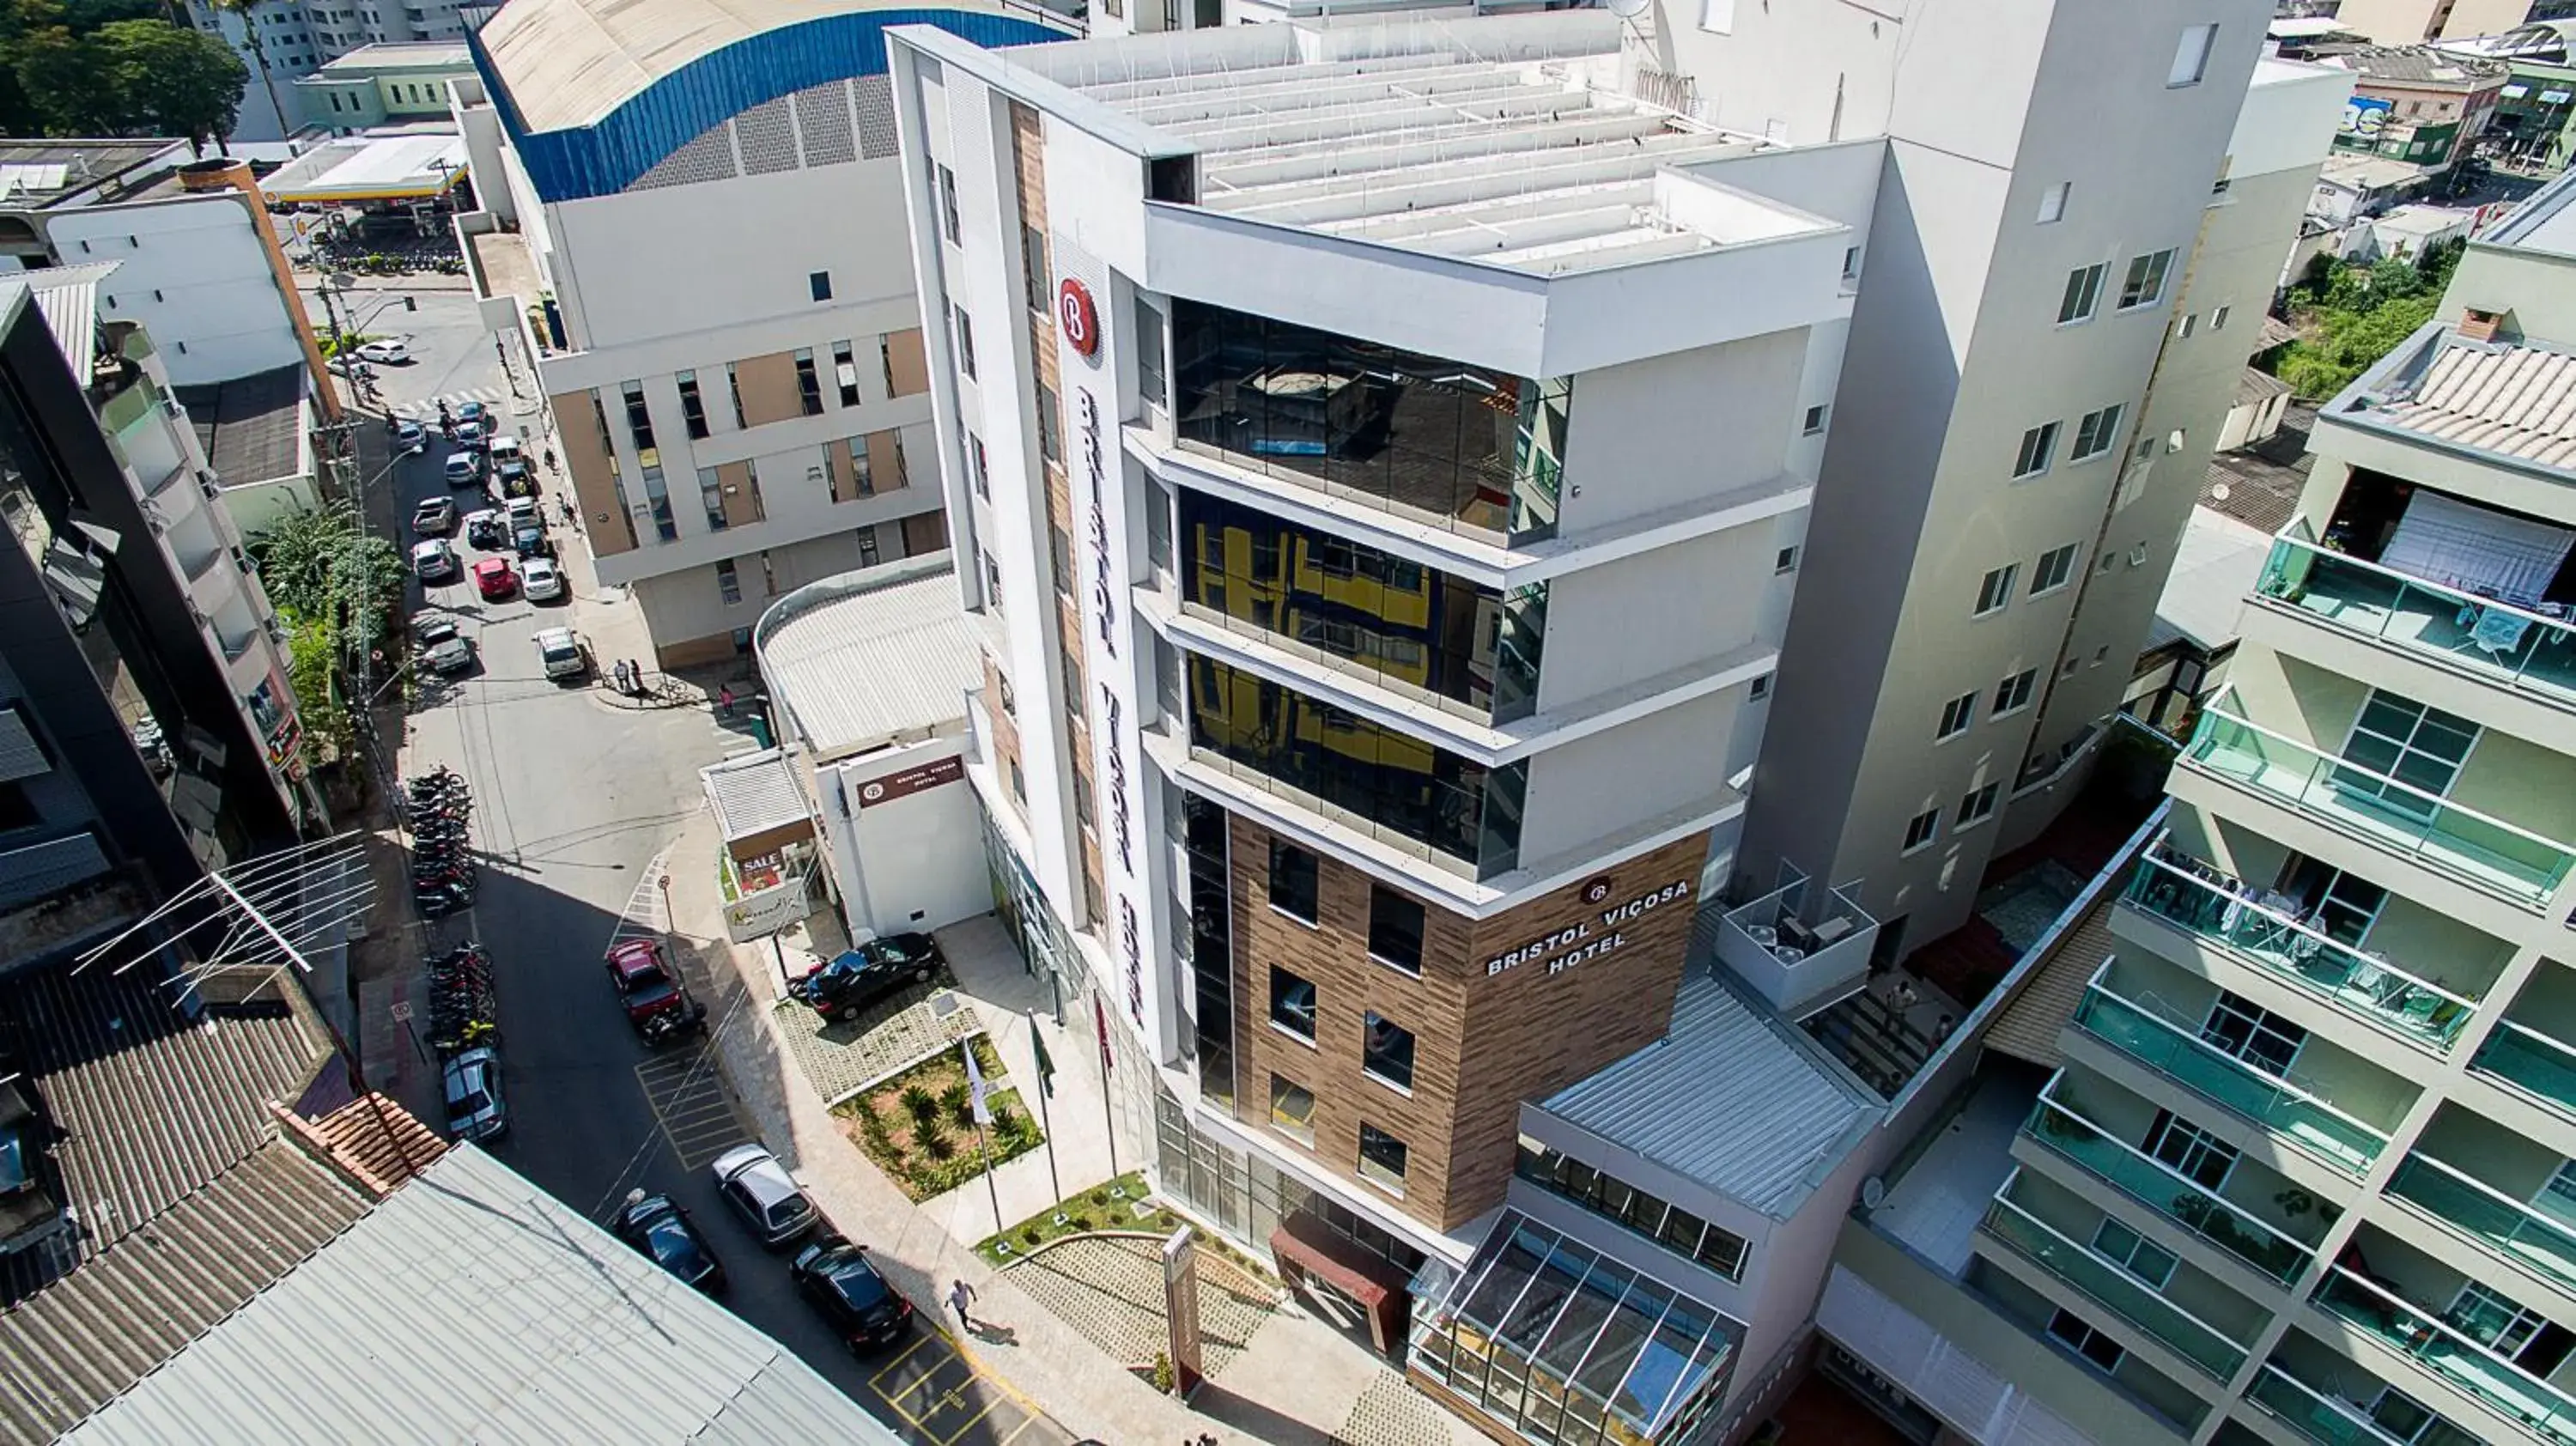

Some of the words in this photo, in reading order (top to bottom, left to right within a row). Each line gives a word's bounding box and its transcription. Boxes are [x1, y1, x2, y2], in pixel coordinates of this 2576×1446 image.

[744, 853, 780, 872] SALE
[1487, 924, 1590, 976] BRISTOL
[1603, 881, 1689, 927] VIÇOSA
[1548, 933, 1626, 975] HOTEL
